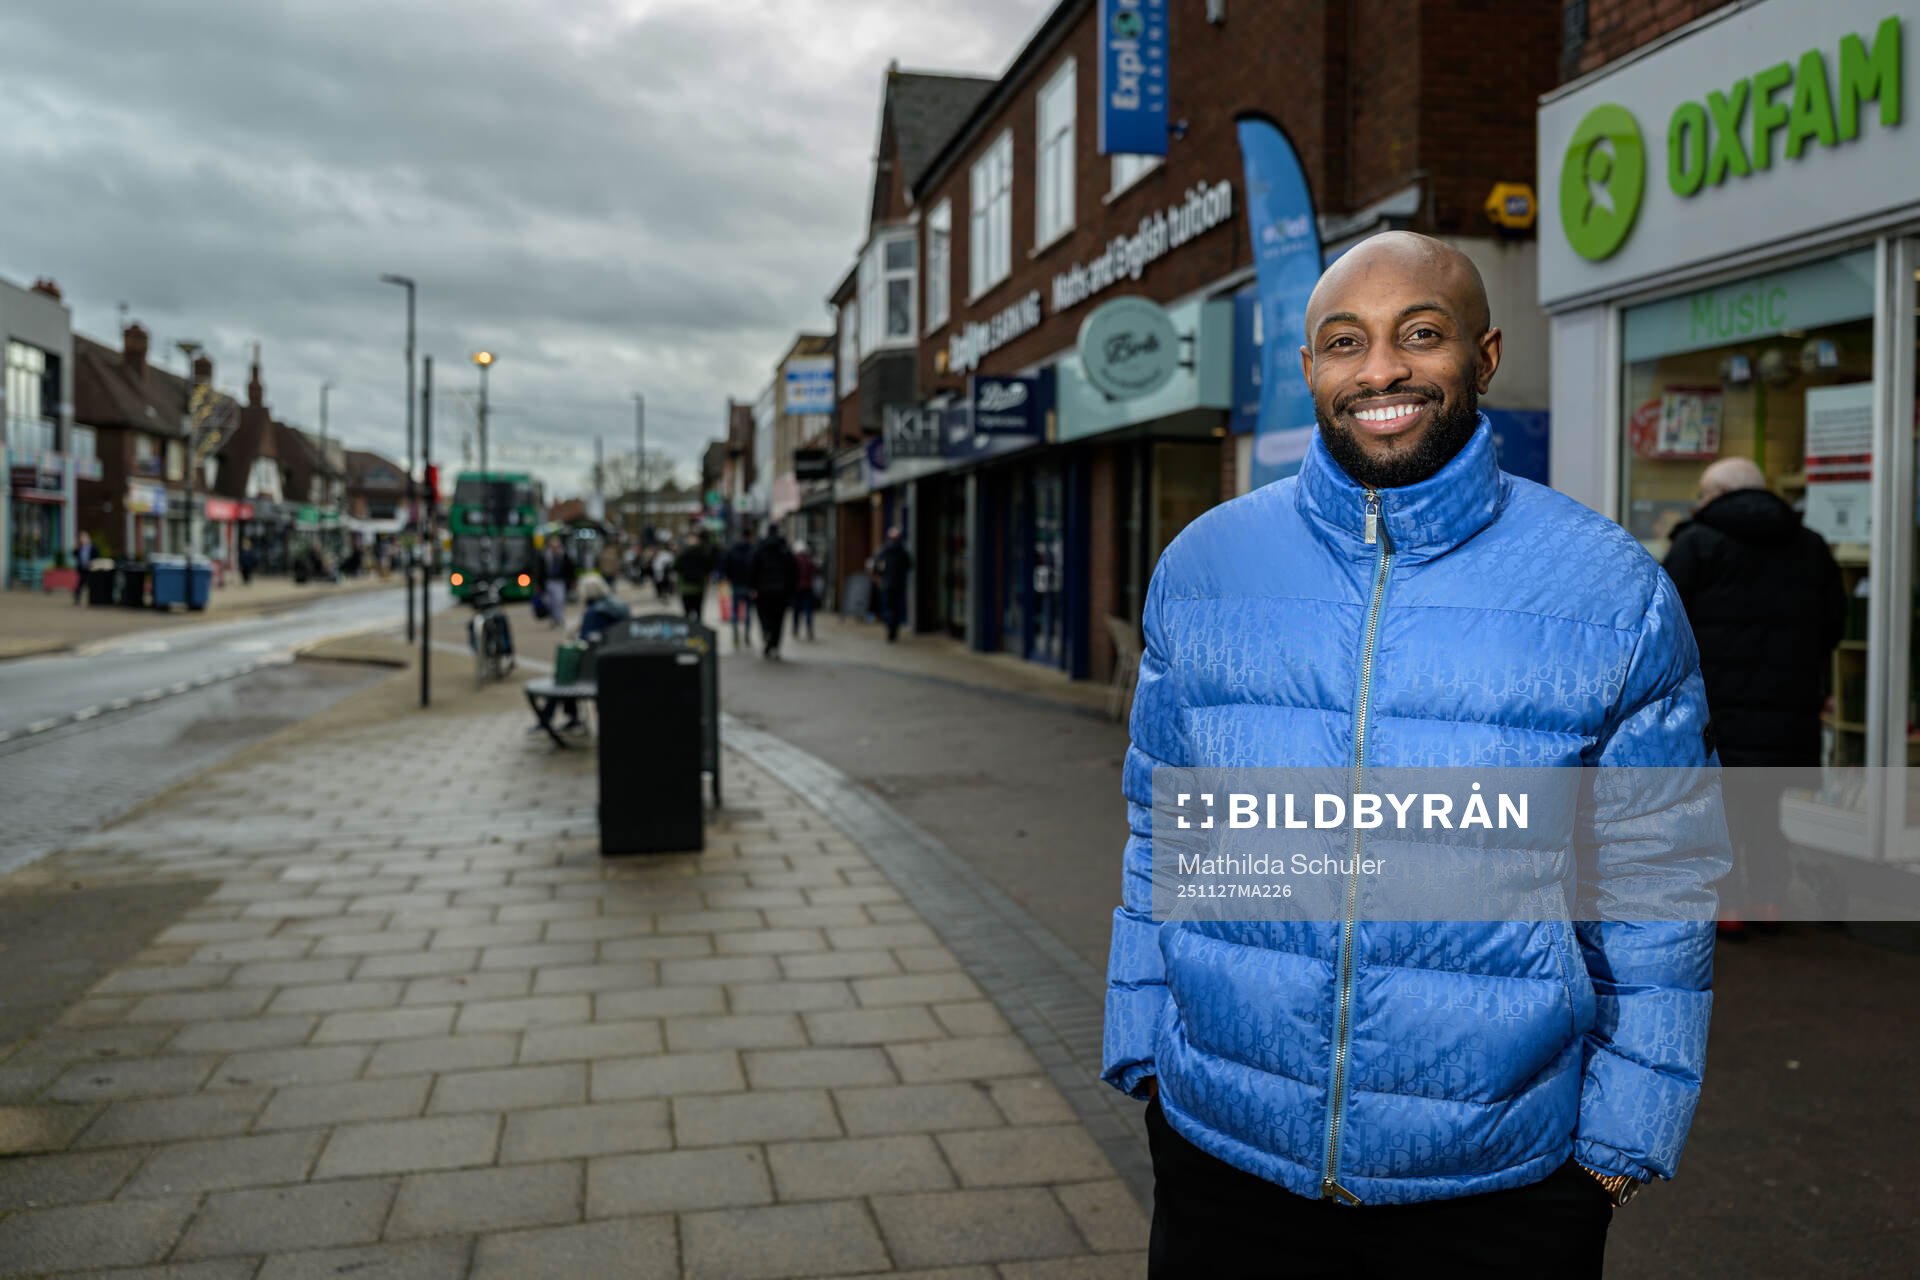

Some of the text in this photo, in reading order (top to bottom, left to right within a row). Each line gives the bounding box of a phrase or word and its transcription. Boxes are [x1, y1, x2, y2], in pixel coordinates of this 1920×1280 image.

[1667, 14, 1903, 199] OXFAM
[1167, 179, 1233, 249] tuition
[892, 408, 940, 441] KH
